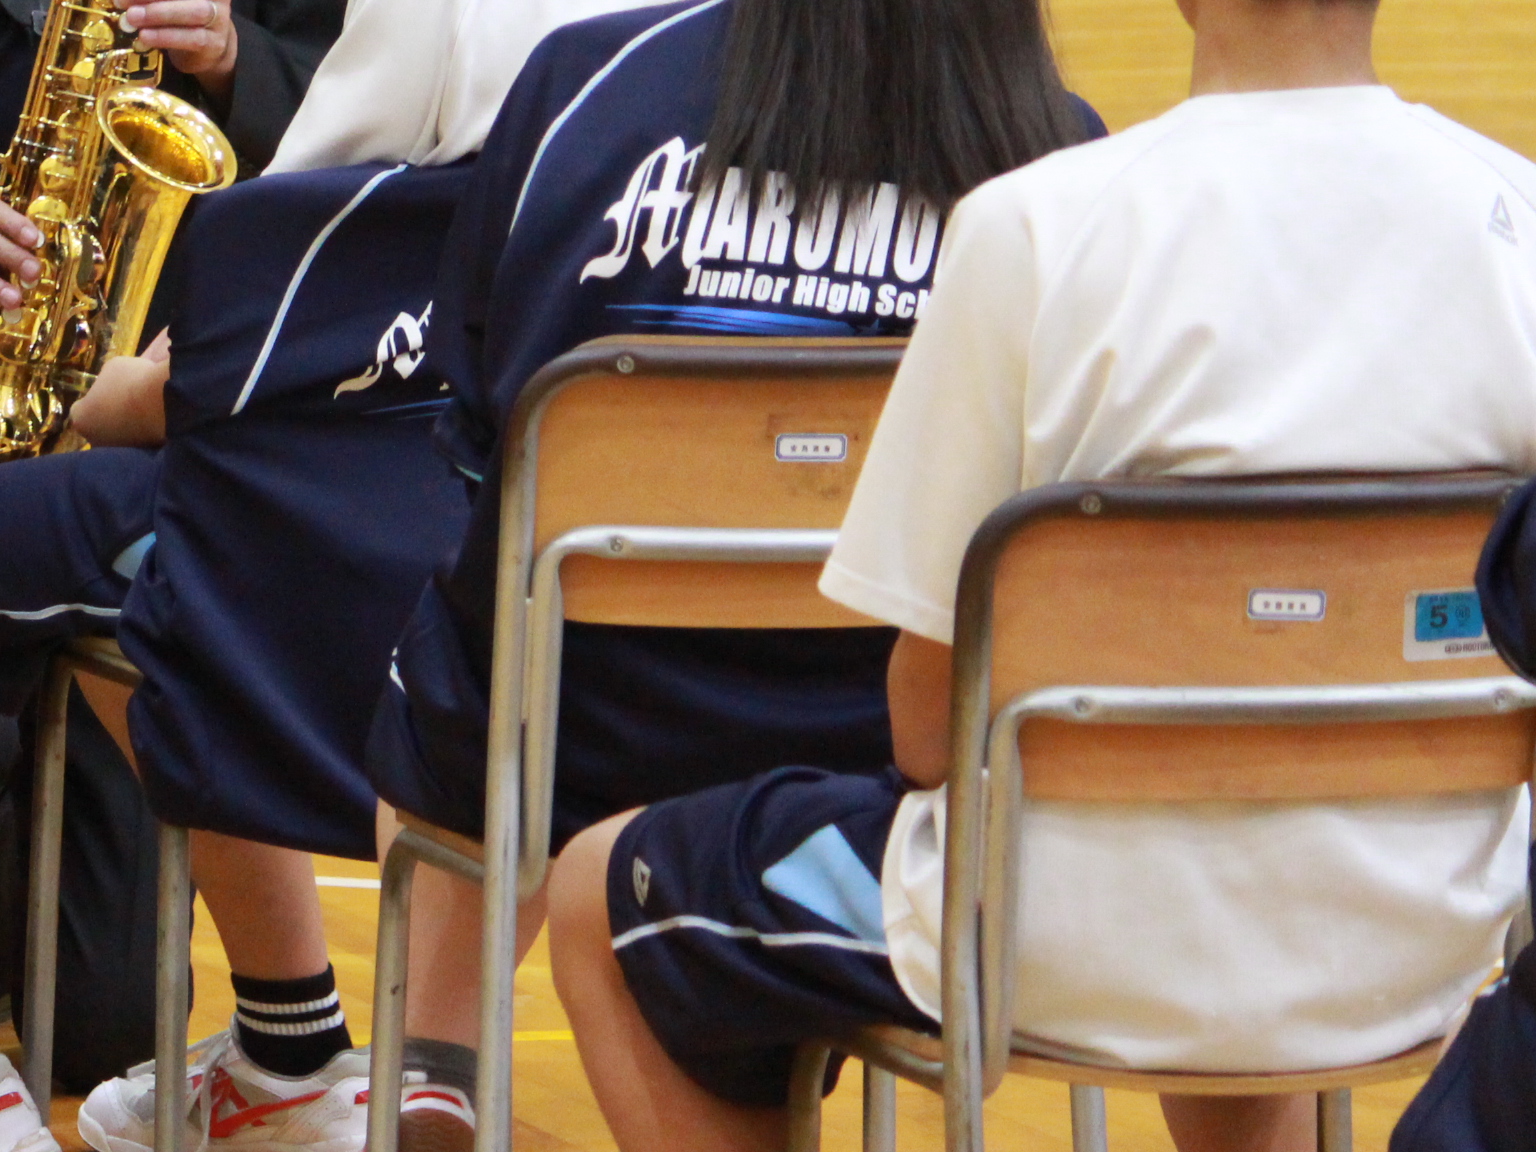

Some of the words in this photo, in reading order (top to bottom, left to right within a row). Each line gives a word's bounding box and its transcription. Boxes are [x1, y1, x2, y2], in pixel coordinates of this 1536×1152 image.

[579, 136, 944, 283] MARUMO
[683, 265, 791, 304] Junior
[792, 274, 871, 314] High
[1429, 605, 1448, 628] 5
